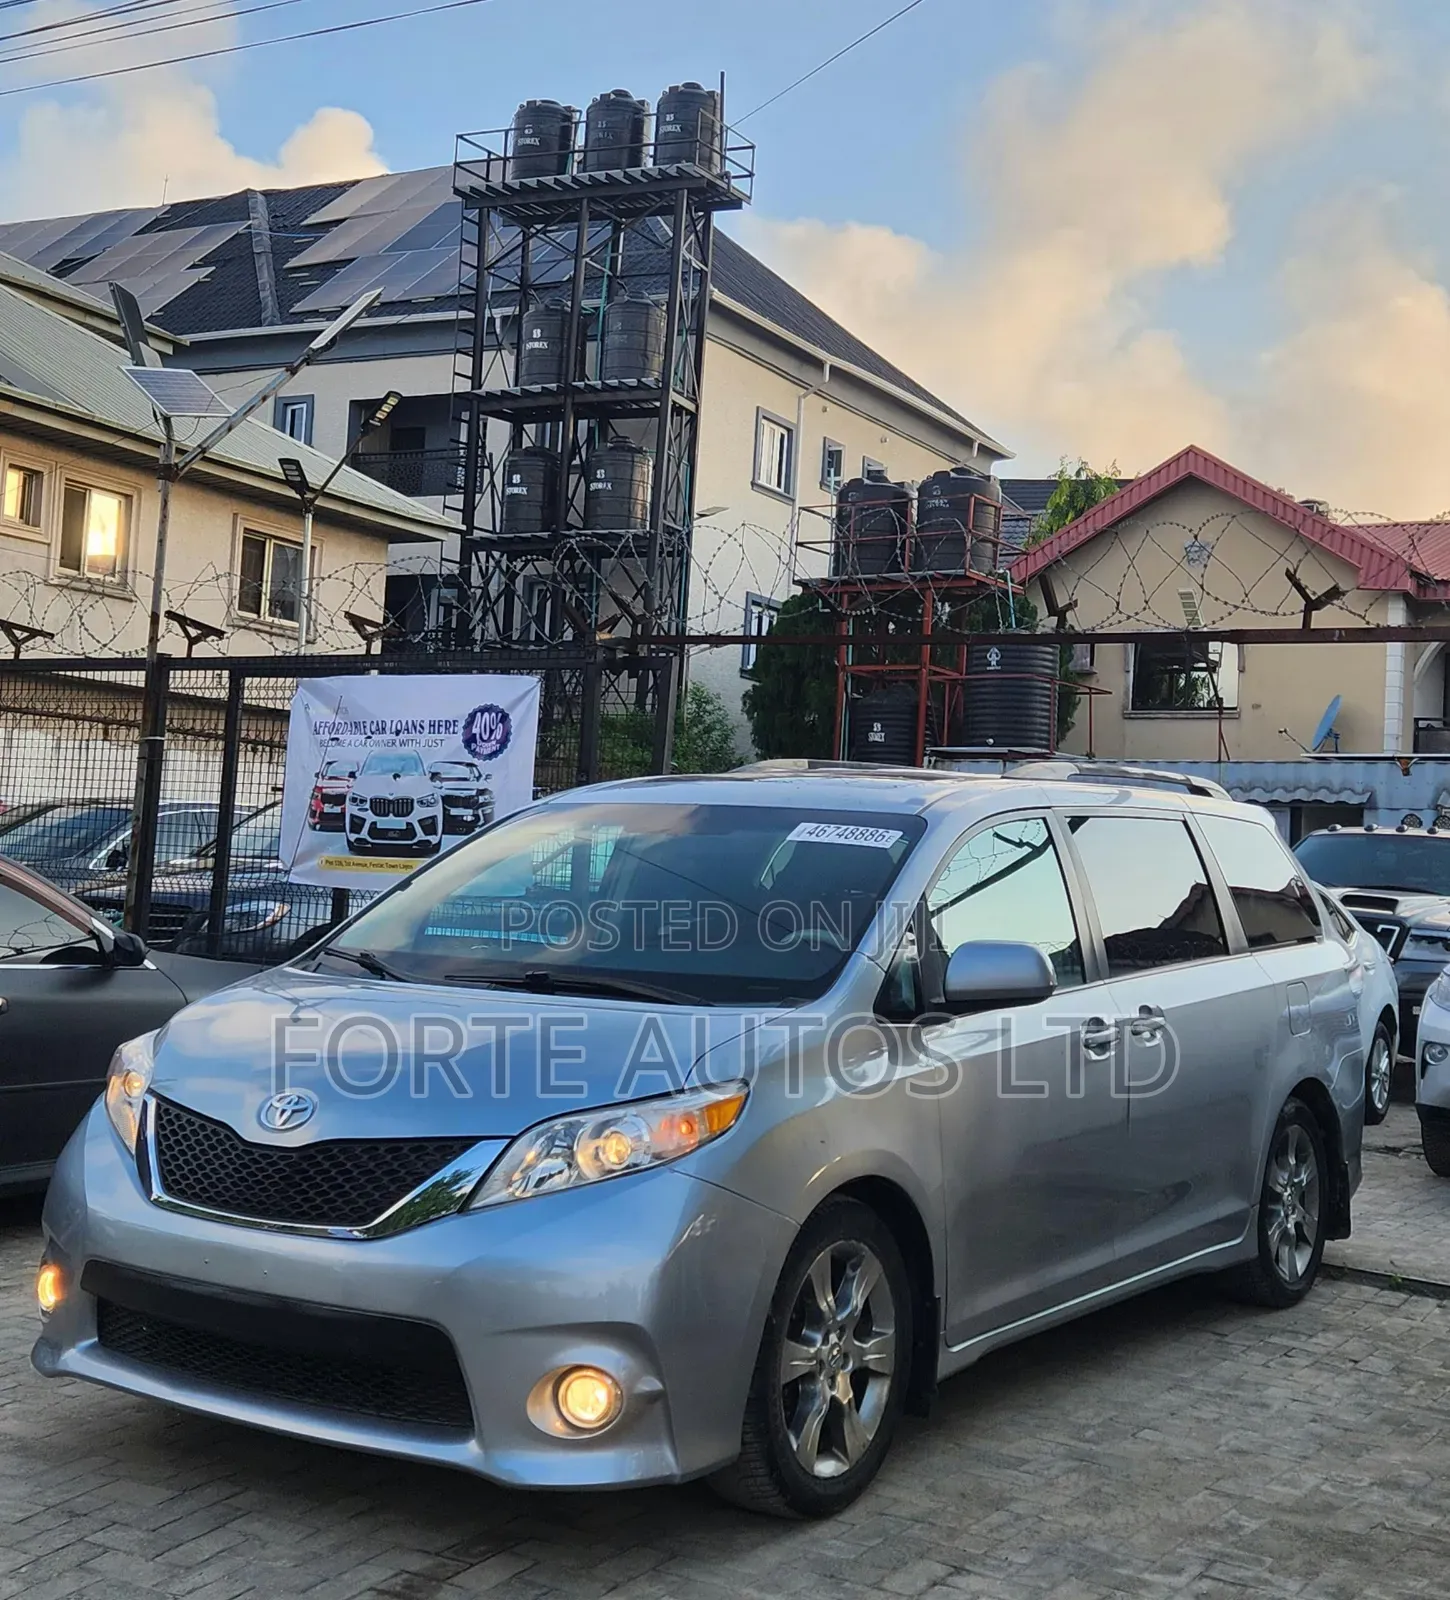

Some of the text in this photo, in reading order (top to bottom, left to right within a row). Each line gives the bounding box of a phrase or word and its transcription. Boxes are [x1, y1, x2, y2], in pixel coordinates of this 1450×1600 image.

[312, 719, 459, 736] AFFORDABLE CAR LOANS HERE
[471, 711, 503, 741] 40%
[399, 738, 421, 748] WITH
[421, 738, 445, 748] JUST
